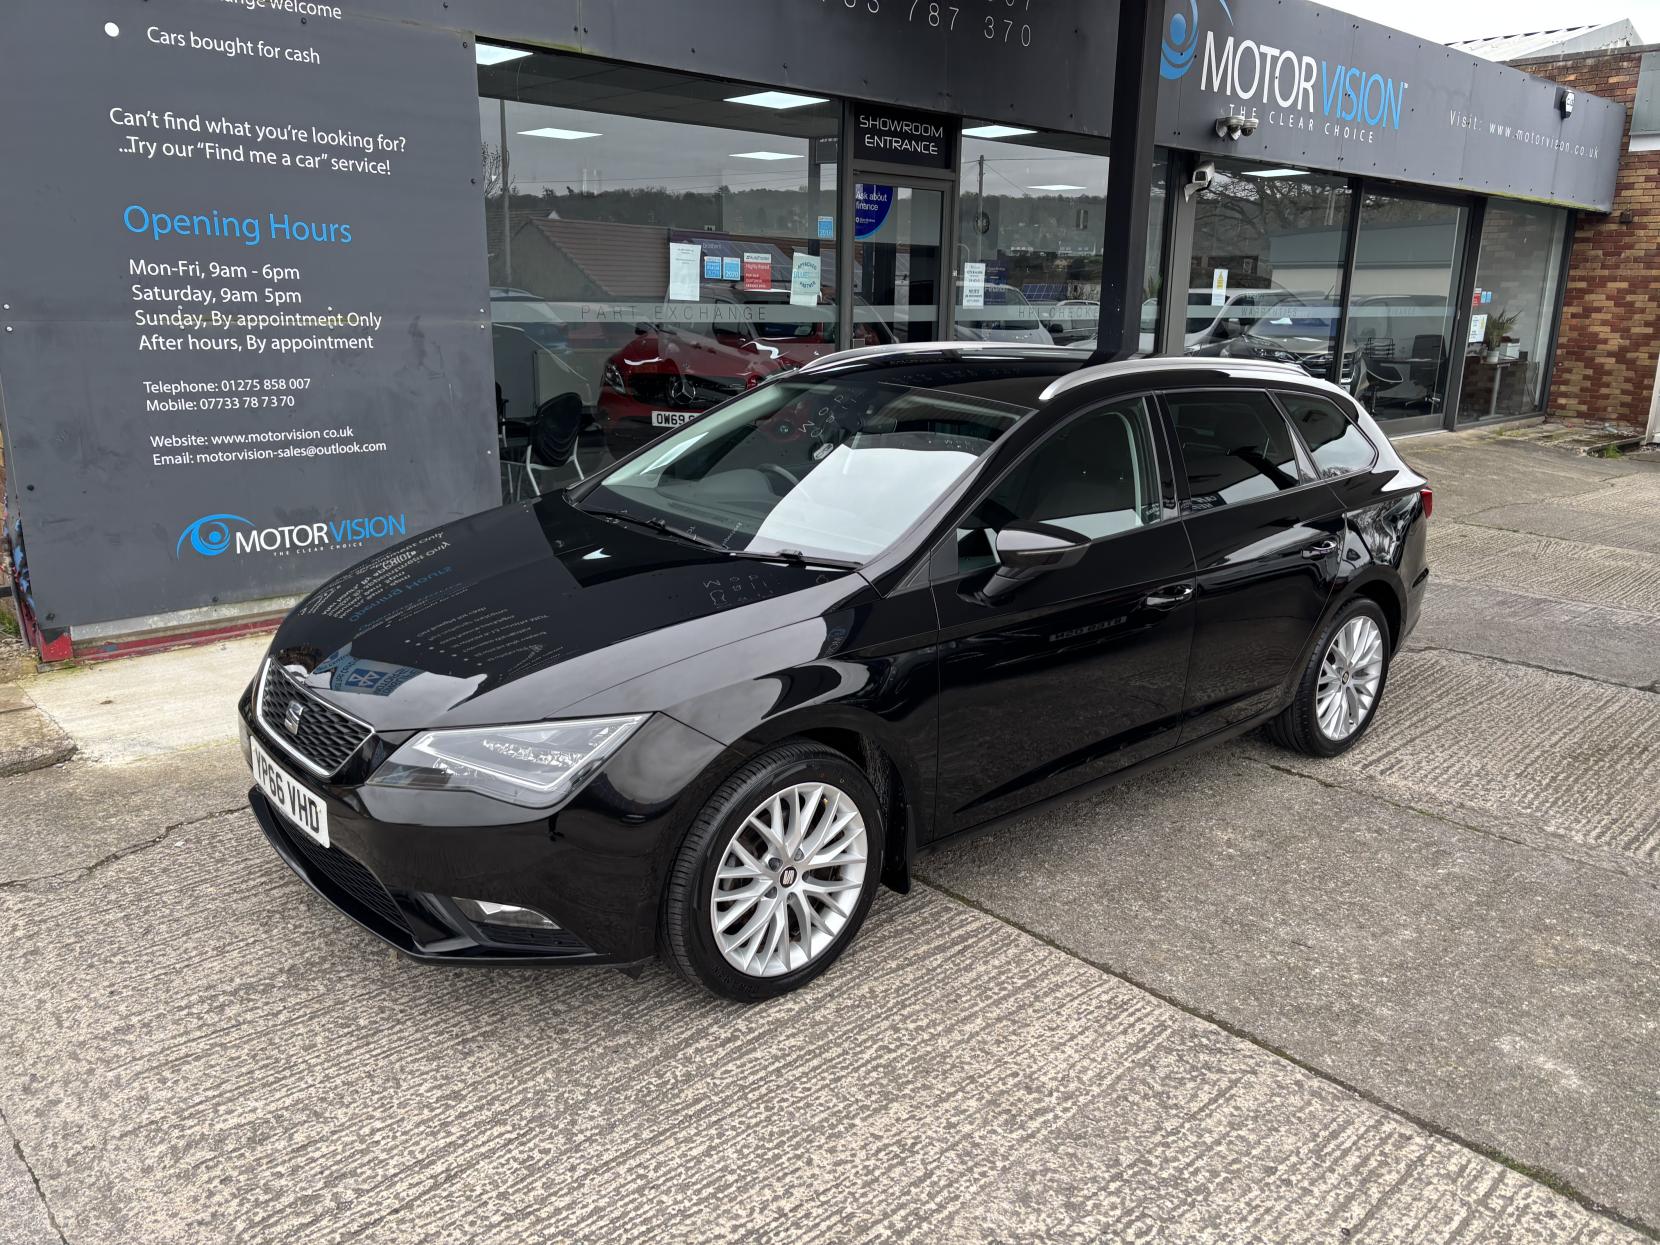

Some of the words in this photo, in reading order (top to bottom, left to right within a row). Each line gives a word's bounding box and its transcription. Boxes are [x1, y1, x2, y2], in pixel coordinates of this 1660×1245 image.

[270, 0, 342, 19] welcome
[983, 15, 1031, 47] 370
[147, 27, 185, 46] Cars
[190, 31, 254, 56] bought
[257, 41, 280, 58] for
[285, 48, 320, 64] cash
[110, 108, 159, 128] Can't
[163, 112, 200, 131] find
[206, 117, 251, 136] what
[255, 125, 307, 142] you're
[312, 127, 373, 152] looking
[377, 134, 405, 152] for?
[859, 115, 943, 138] SHOWROOM
[1229, 104, 1257, 119] THE
[1269, 111, 1314, 131] CLEAR
[1324, 122, 1374, 143] CHOICE
[1450, 109, 1482, 131] Visit:
[865, 134, 938, 155] ENTRANCE
[163, 144, 194, 157] our
[250, 151, 276, 164] me
[282, 154, 291, 165] a
[331, 158, 390, 175] service!
[869, 191, 888, 202] about
[124, 205, 259, 245] Opening
[270, 214, 351, 242] Hours
[130, 259, 204, 279] Mon-Fri,
[210, 262, 247, 278] 9am
[263, 264, 299, 282] 6pm
[132, 285, 216, 305] Saturday,
[221, 288, 257, 302] 9am
[265, 288, 301, 306] 5pm
[135, 310, 206, 329] Sunday,
[212, 311, 234, 329] By
[237, 312, 343, 329] appointment
[347, 312, 381, 330] Only
[581, 305, 639, 320] PART
[654, 306, 767, 321] EXCHANGE
[139, 334, 183, 350] After
[188, 334, 242, 352] hours,
[247, 335, 266, 353] By
[272, 335, 373, 353] appointment
[143, 380, 218, 395] Telephone:
[221, 380, 260, 391] 01275
[264, 379, 286, 390] 858
[289, 379, 310, 389] 007
[147, 399, 197, 411] Mobile:
[200, 398, 239, 409] 07733
[150, 435, 208, 447] Website:
[153, 452, 194, 465] Email:
[197, 442, 386, 462] motorvision-sales@outlook.com
[255, 750, 285, 806] YP66
[287, 780, 320, 834] VHD
